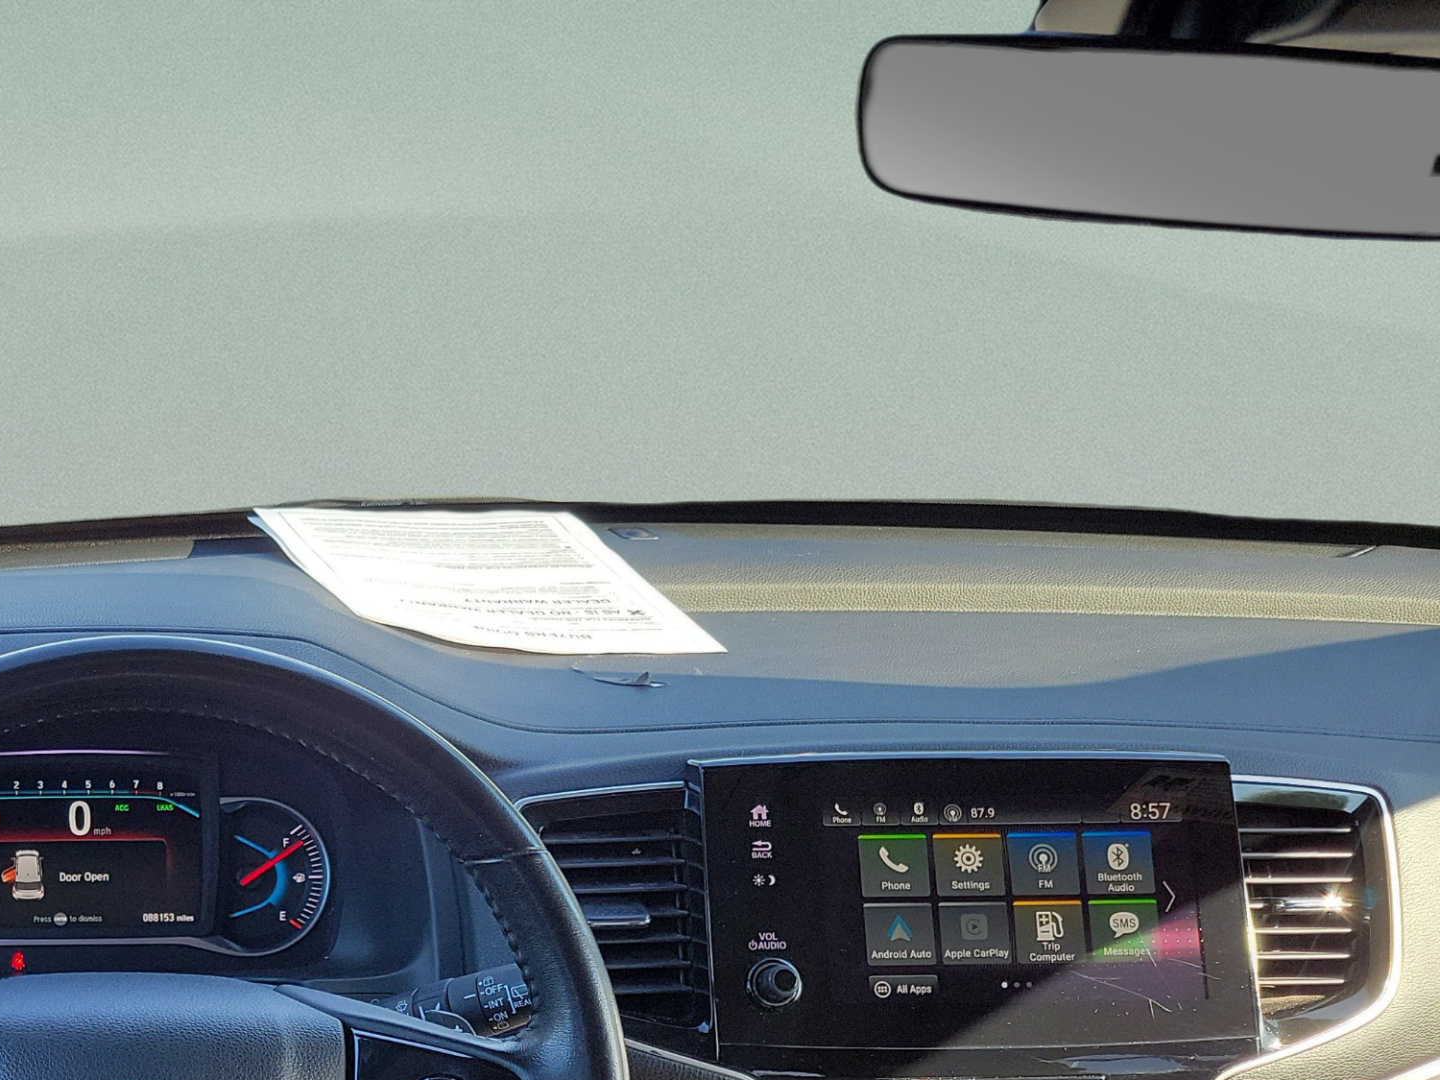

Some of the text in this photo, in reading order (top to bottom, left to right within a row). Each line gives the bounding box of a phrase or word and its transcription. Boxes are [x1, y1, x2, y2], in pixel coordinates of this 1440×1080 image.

[14, 781, 20, 789] 2
[37, 781, 44, 789] 3
[61, 781, 68, 789] 4
[85, 780, 92, 789] 5
[109, 780, 116, 789] 6
[133, 780, 140, 788] 7
[156, 781, 163, 790] 8
[970, 807, 995, 819] 87.9
[1130, 802, 1171, 820] 8:57
[68, 801, 112, 837] 0 mph
[749, 820, 772, 828] HOME
[832, 816, 852, 824] Phone
[282, 837, 290, 848] F
[751, 851, 773, 859] BACK
[59, 872, 110, 883] Door Open
[1097, 872, 1143, 882] Bluetooth
[881, 881, 911, 891] Phone
[951, 881, 990, 892] Settings
[1038, 880, 1054, 889] FM
[1108, 883, 1135, 892] Audio
[33, 915, 52, 923] Press
[142, 913, 175, 923] 088153
[279, 910, 287, 921] E
[1112, 918, 1136, 928] SMS
[758, 932, 778, 941] VOL
[758, 941, 787, 950] AUDIO
[1042, 942, 1061, 952] Trip
[871, 950, 932, 959] Android Auto
[944, 949, 1009, 960] Apple CarPlay
[1103, 947, 1151, 957] Messages
[1029, 952, 1076, 963] Computer
[485, 983, 503, 996] OFF
[896, 984, 932, 995] All Apps
[488, 997, 504, 1010] INT
[493, 1011, 509, 1021] ON
